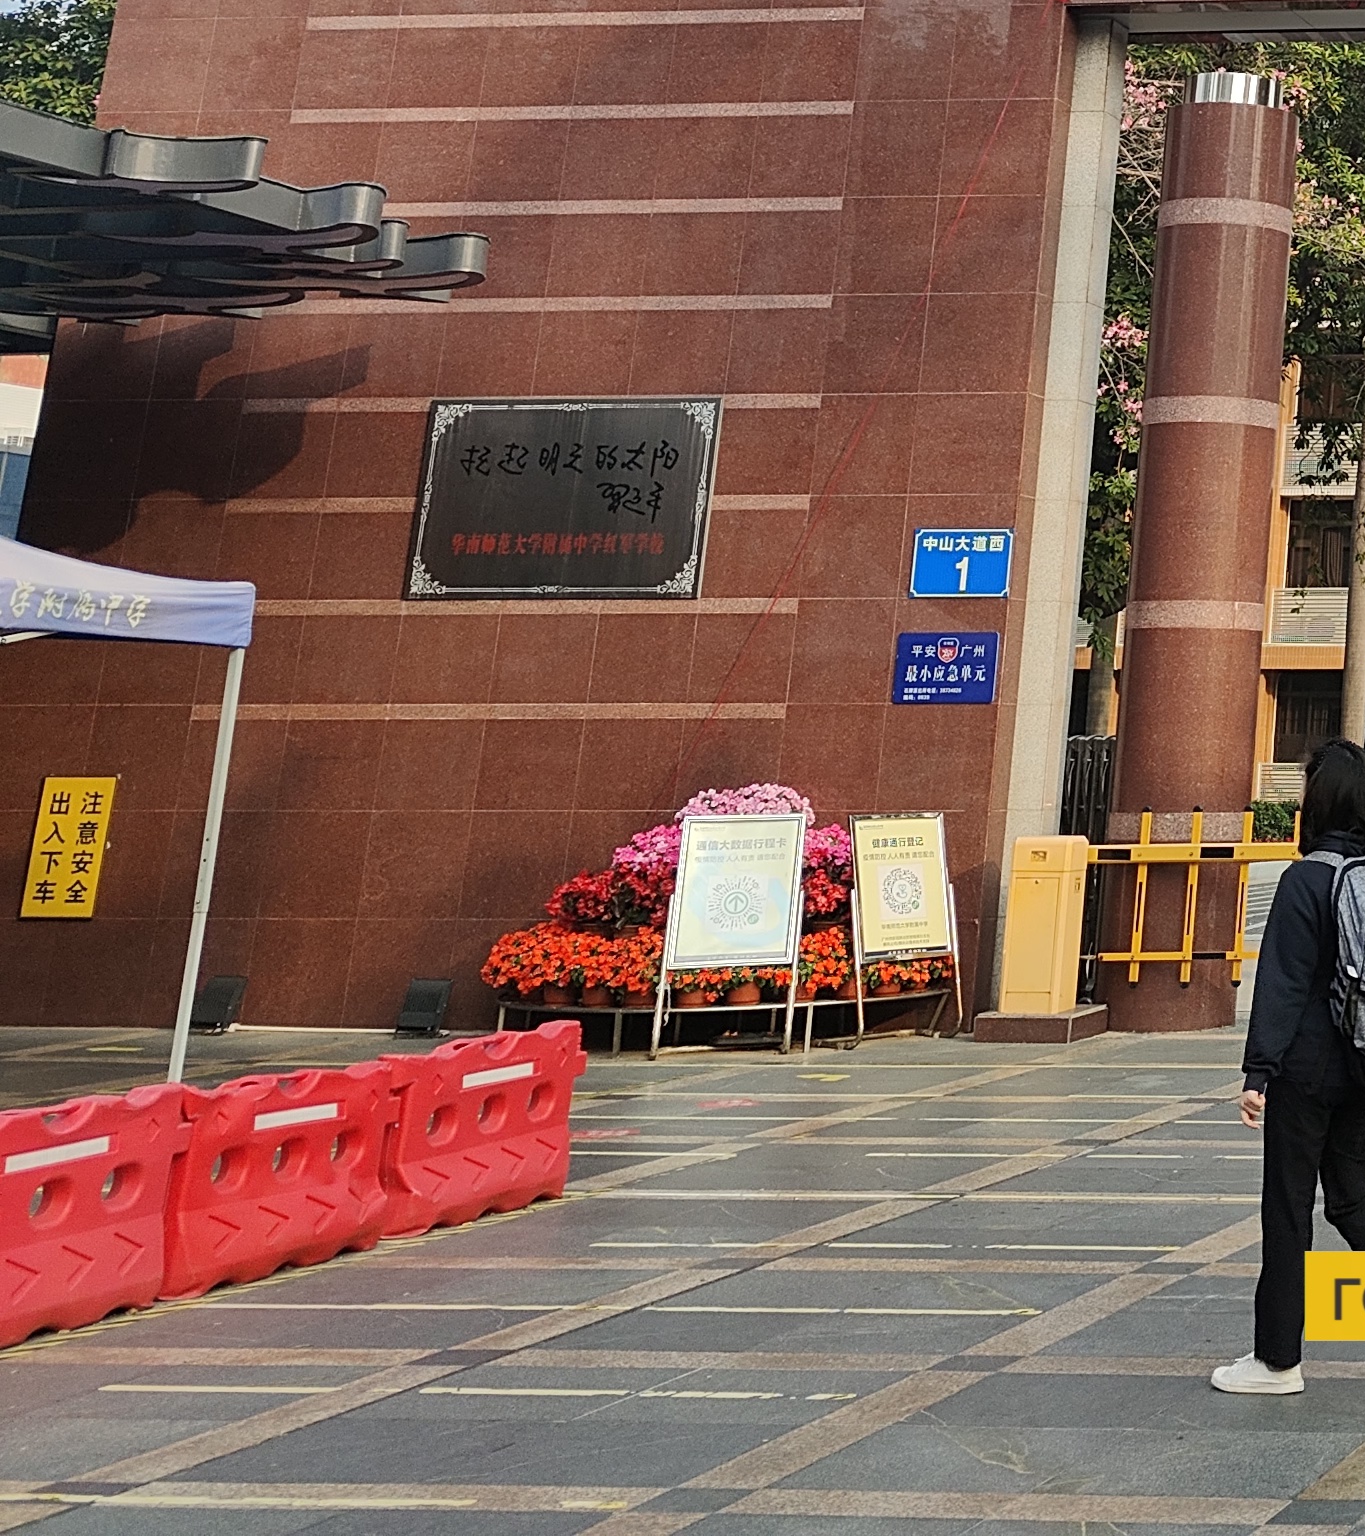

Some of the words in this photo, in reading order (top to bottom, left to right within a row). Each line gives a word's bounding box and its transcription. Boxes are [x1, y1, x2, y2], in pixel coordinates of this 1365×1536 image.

[922, 535, 1006, 552] 中山大道西
[955, 556, 969, 592] 1
[0, 579, 152, 628] 学附属中学
[911, 645, 936, 658] 平安
[960, 644, 985, 658] 广州
[904, 664, 986, 683] 最小应急单元
[33, 791, 71, 904] 出入下车
[65, 790, 104, 904] 注意安全
[696, 837, 787, 851] 通信大数据行程卡
[872, 836, 924, 849] 健康通行登记
